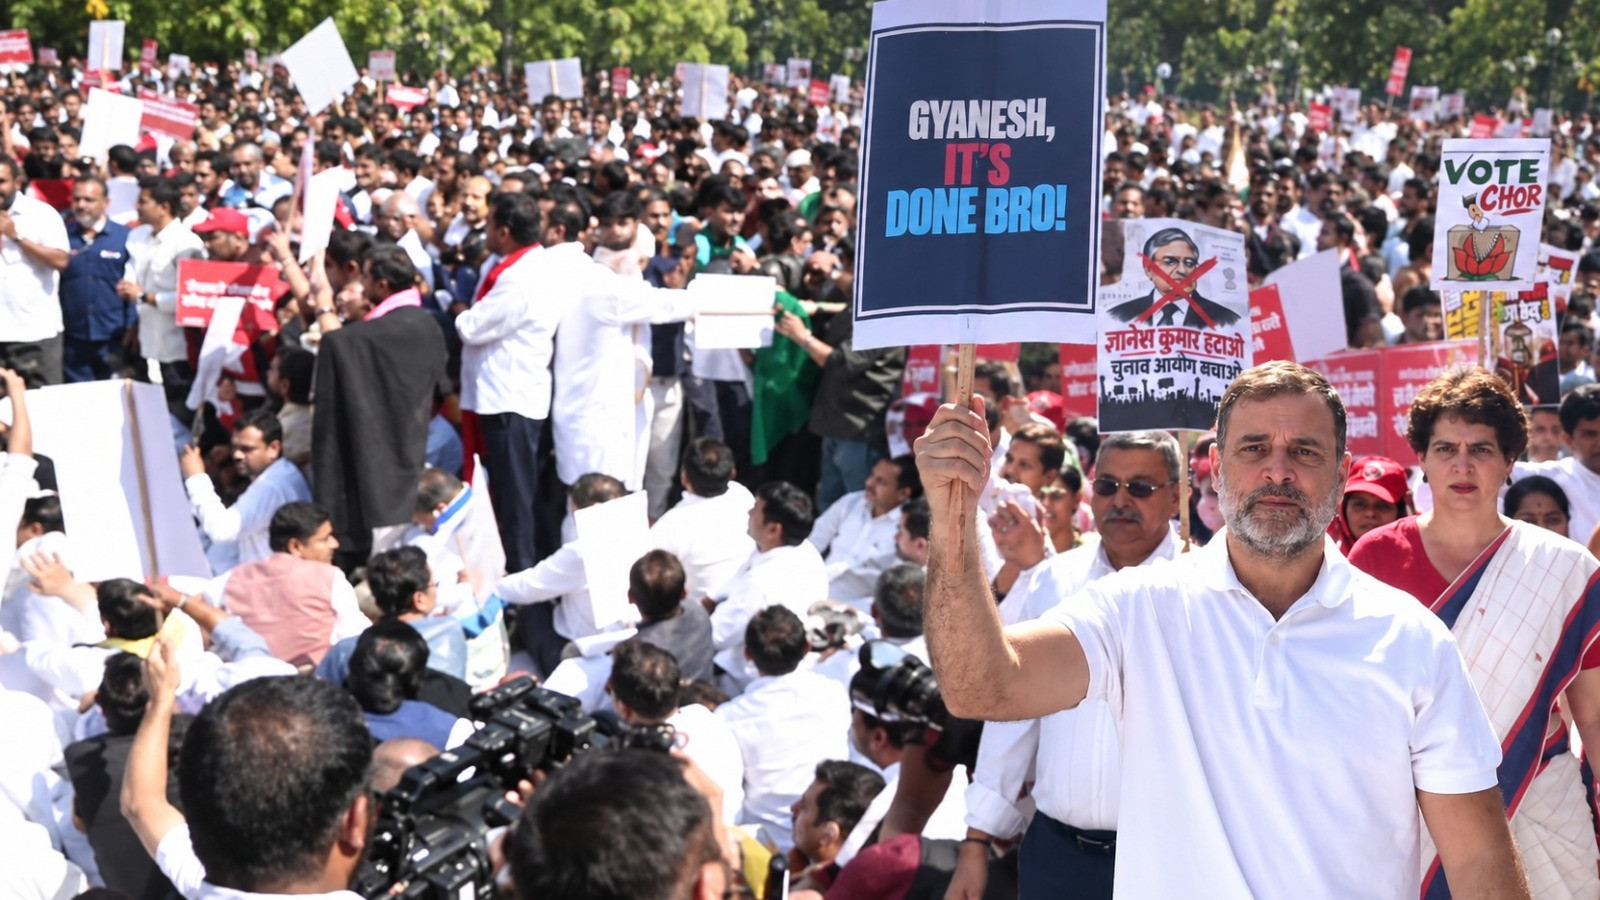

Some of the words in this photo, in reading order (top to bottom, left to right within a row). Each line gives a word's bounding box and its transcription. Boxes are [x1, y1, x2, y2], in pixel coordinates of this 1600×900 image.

[908, 97, 1056, 142] GYANESH,
[944, 143, 1012, 186] IT'S
[1444, 154, 1540, 185] VOTE
[885, 187, 979, 237] DONE
[984, 183, 1068, 235] BRO!
[1480, 184, 1542, 211] CHOR
[1158, 328, 1201, 355] कुमार
[1203, 332, 1245, 358] हटाओ
[1110, 359, 1152, 382] चुनाव
[1153, 351, 1197, 374] आयोग
